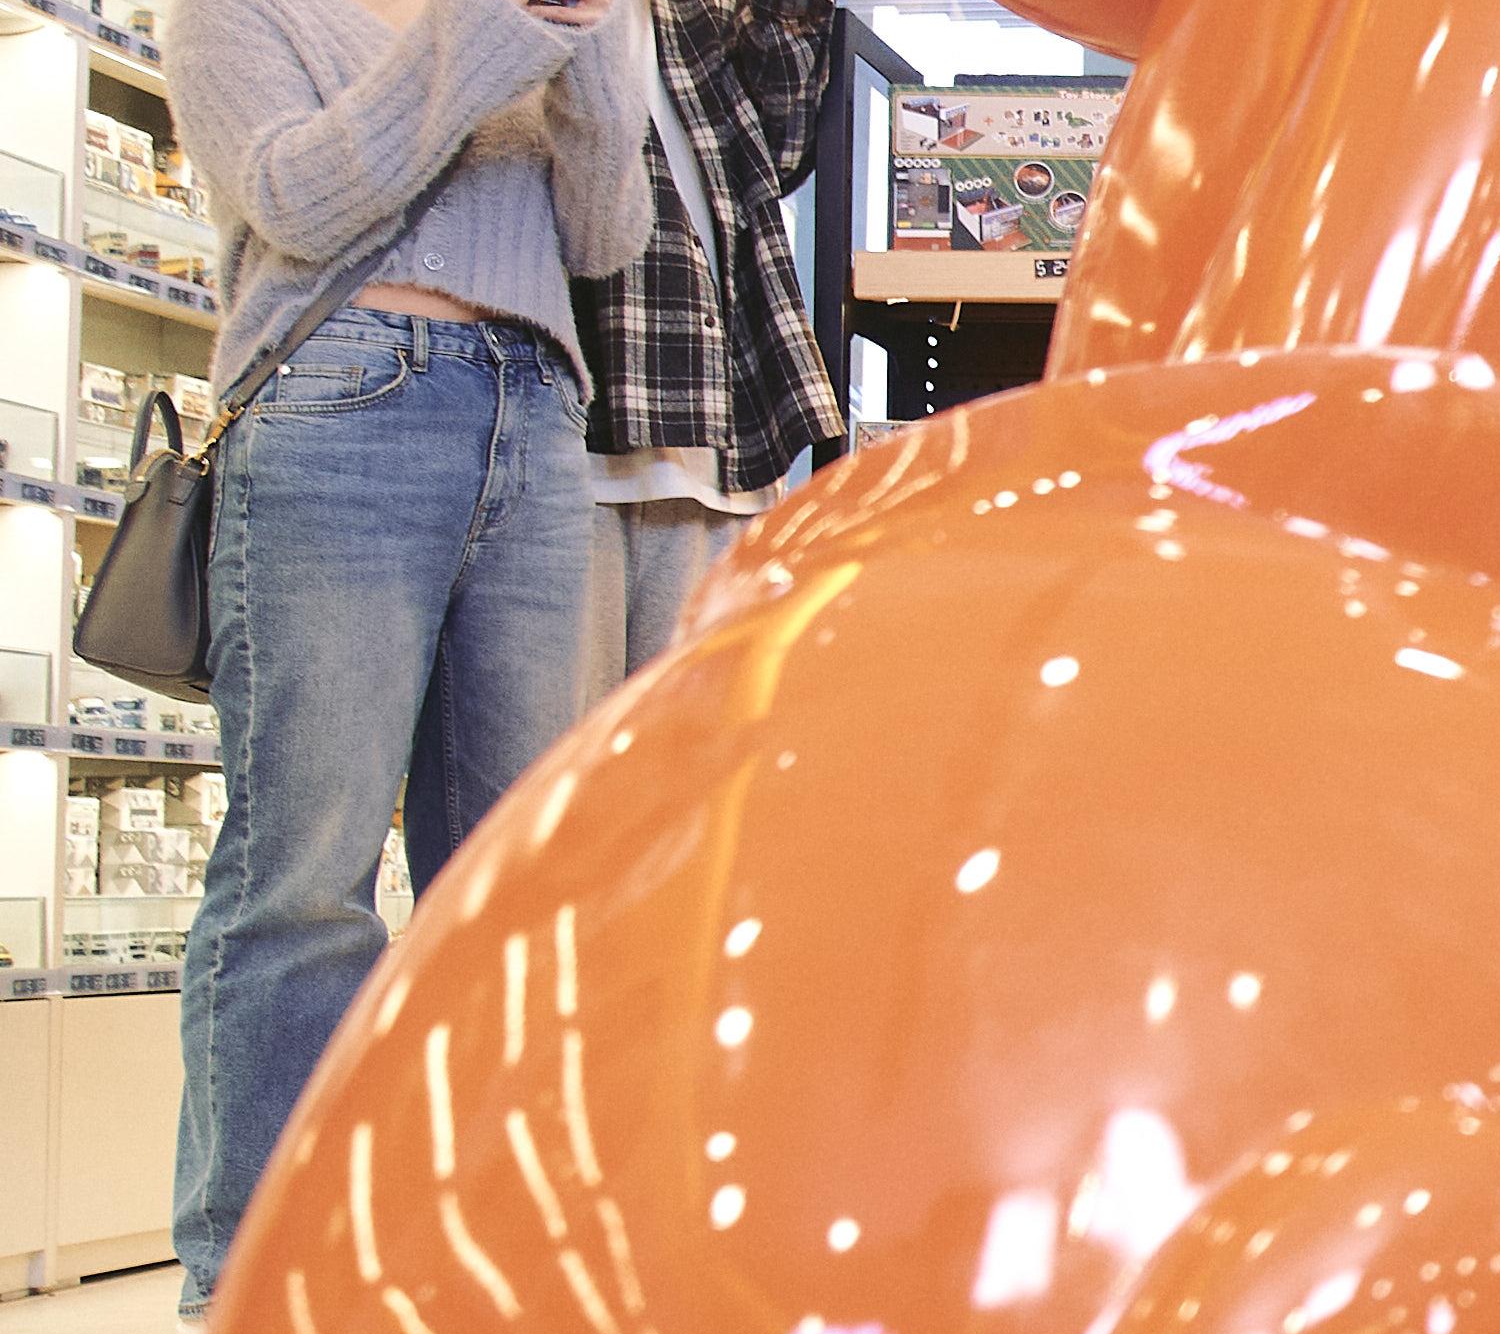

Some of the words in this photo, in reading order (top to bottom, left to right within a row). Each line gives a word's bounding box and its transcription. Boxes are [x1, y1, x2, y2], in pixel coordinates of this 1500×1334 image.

[1058, 91, 1080, 101] Toy
[1081, 92, 1111, 102] Story
[1036, 260, 1046, 277] $
